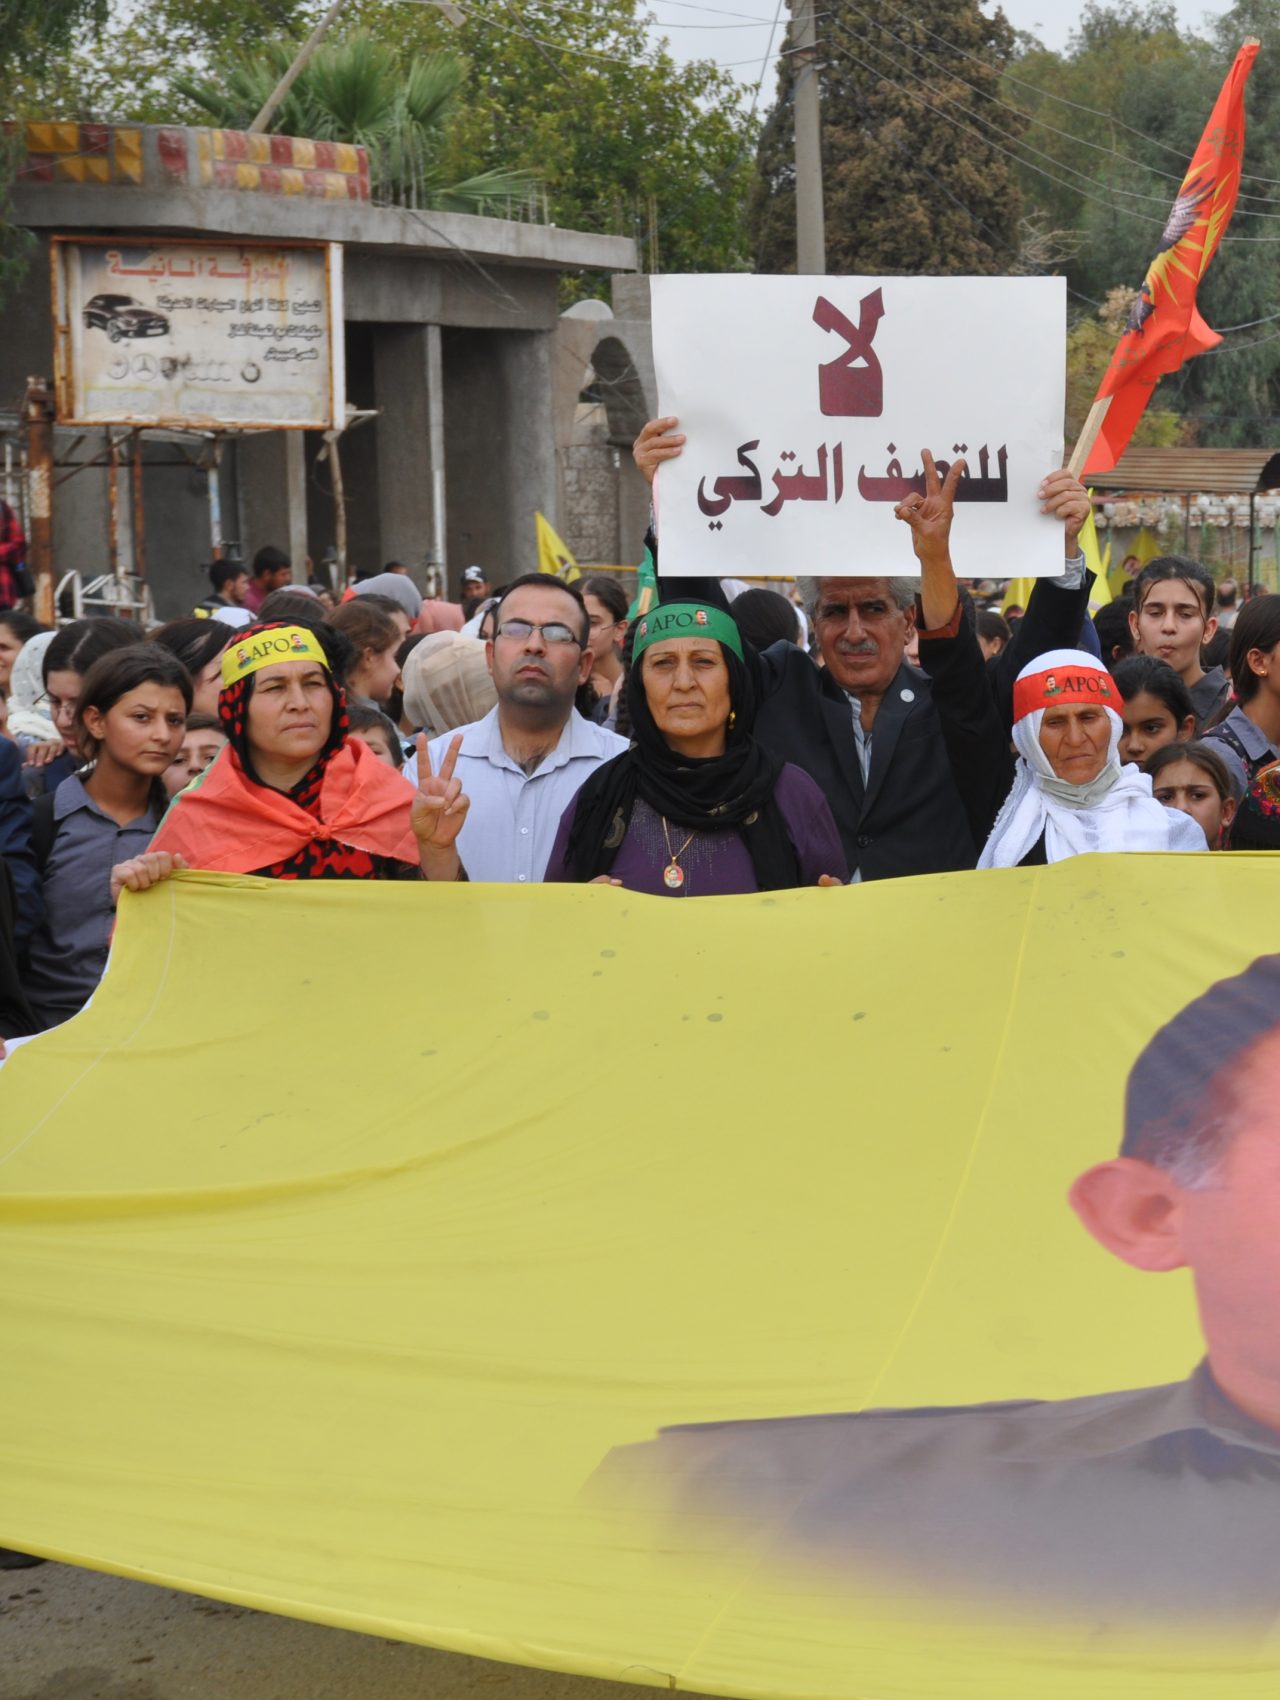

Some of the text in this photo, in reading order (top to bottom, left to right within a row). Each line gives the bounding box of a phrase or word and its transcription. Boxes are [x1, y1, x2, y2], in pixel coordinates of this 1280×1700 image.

[812, 286, 885, 417] لا
[697, 439, 844, 532] التركي
[651, 612, 694, 634] APO
[252, 638, 291, 661] APO
[1062, 675, 1100, 693] APO
